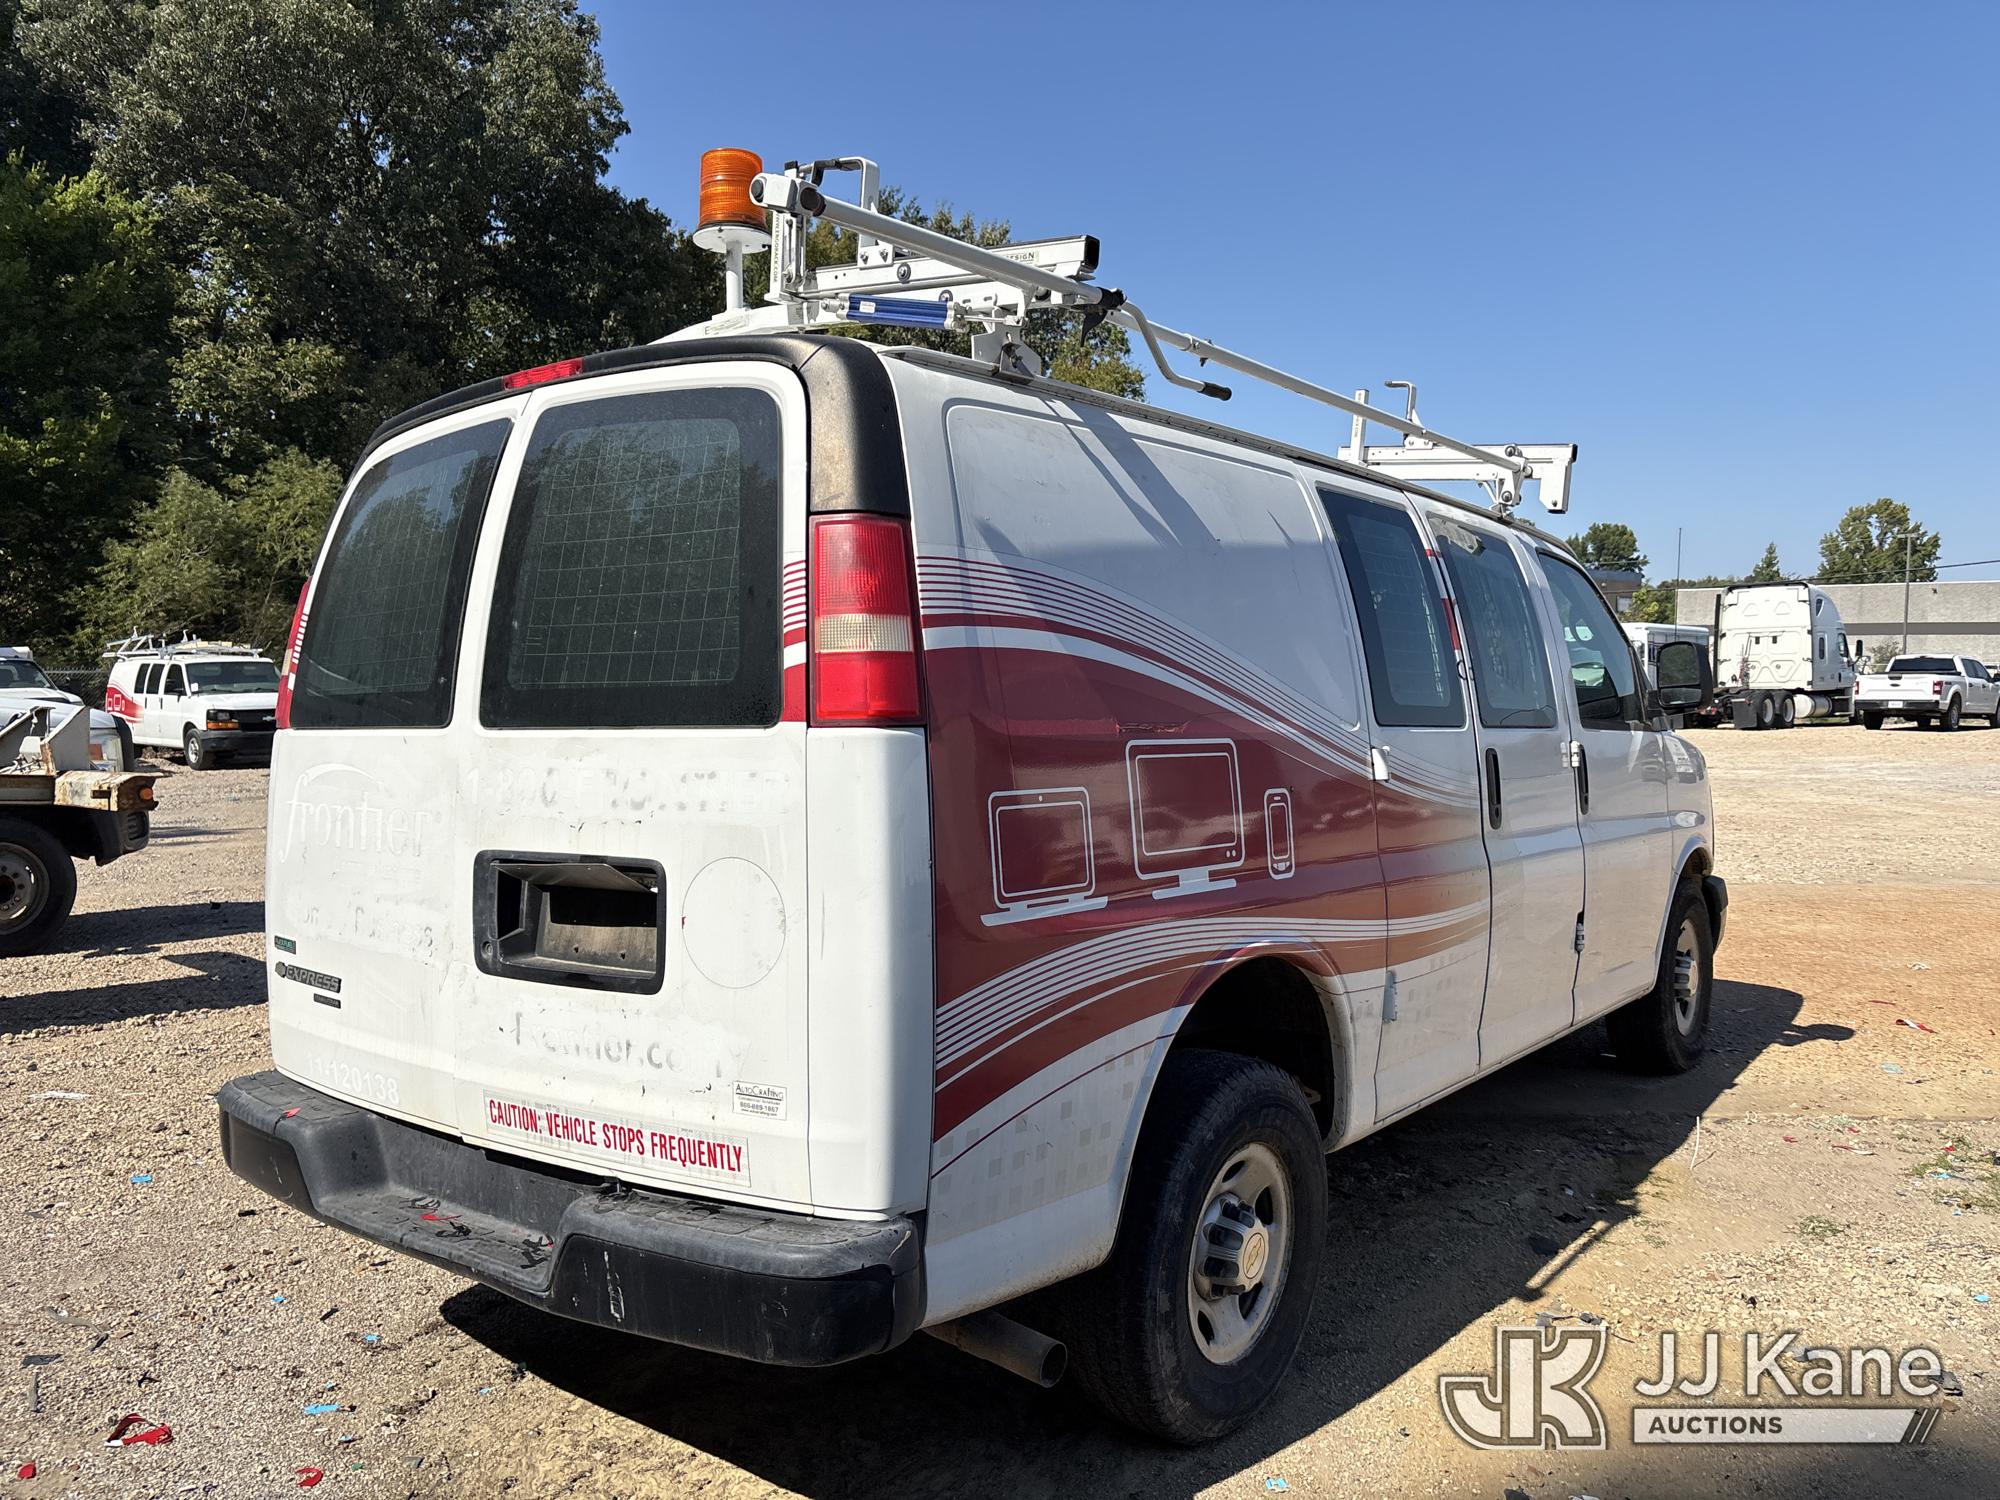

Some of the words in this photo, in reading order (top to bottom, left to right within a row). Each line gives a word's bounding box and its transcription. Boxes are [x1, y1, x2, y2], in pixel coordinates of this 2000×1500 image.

[286, 965, 339, 992] EXPRESS
[489, 1099, 542, 1134] CAUTION:
[546, 1112, 597, 1146] VEHICLE
[603, 1123, 645, 1156] STOPS
[651, 1132, 742, 1173] FREQUENTLY
